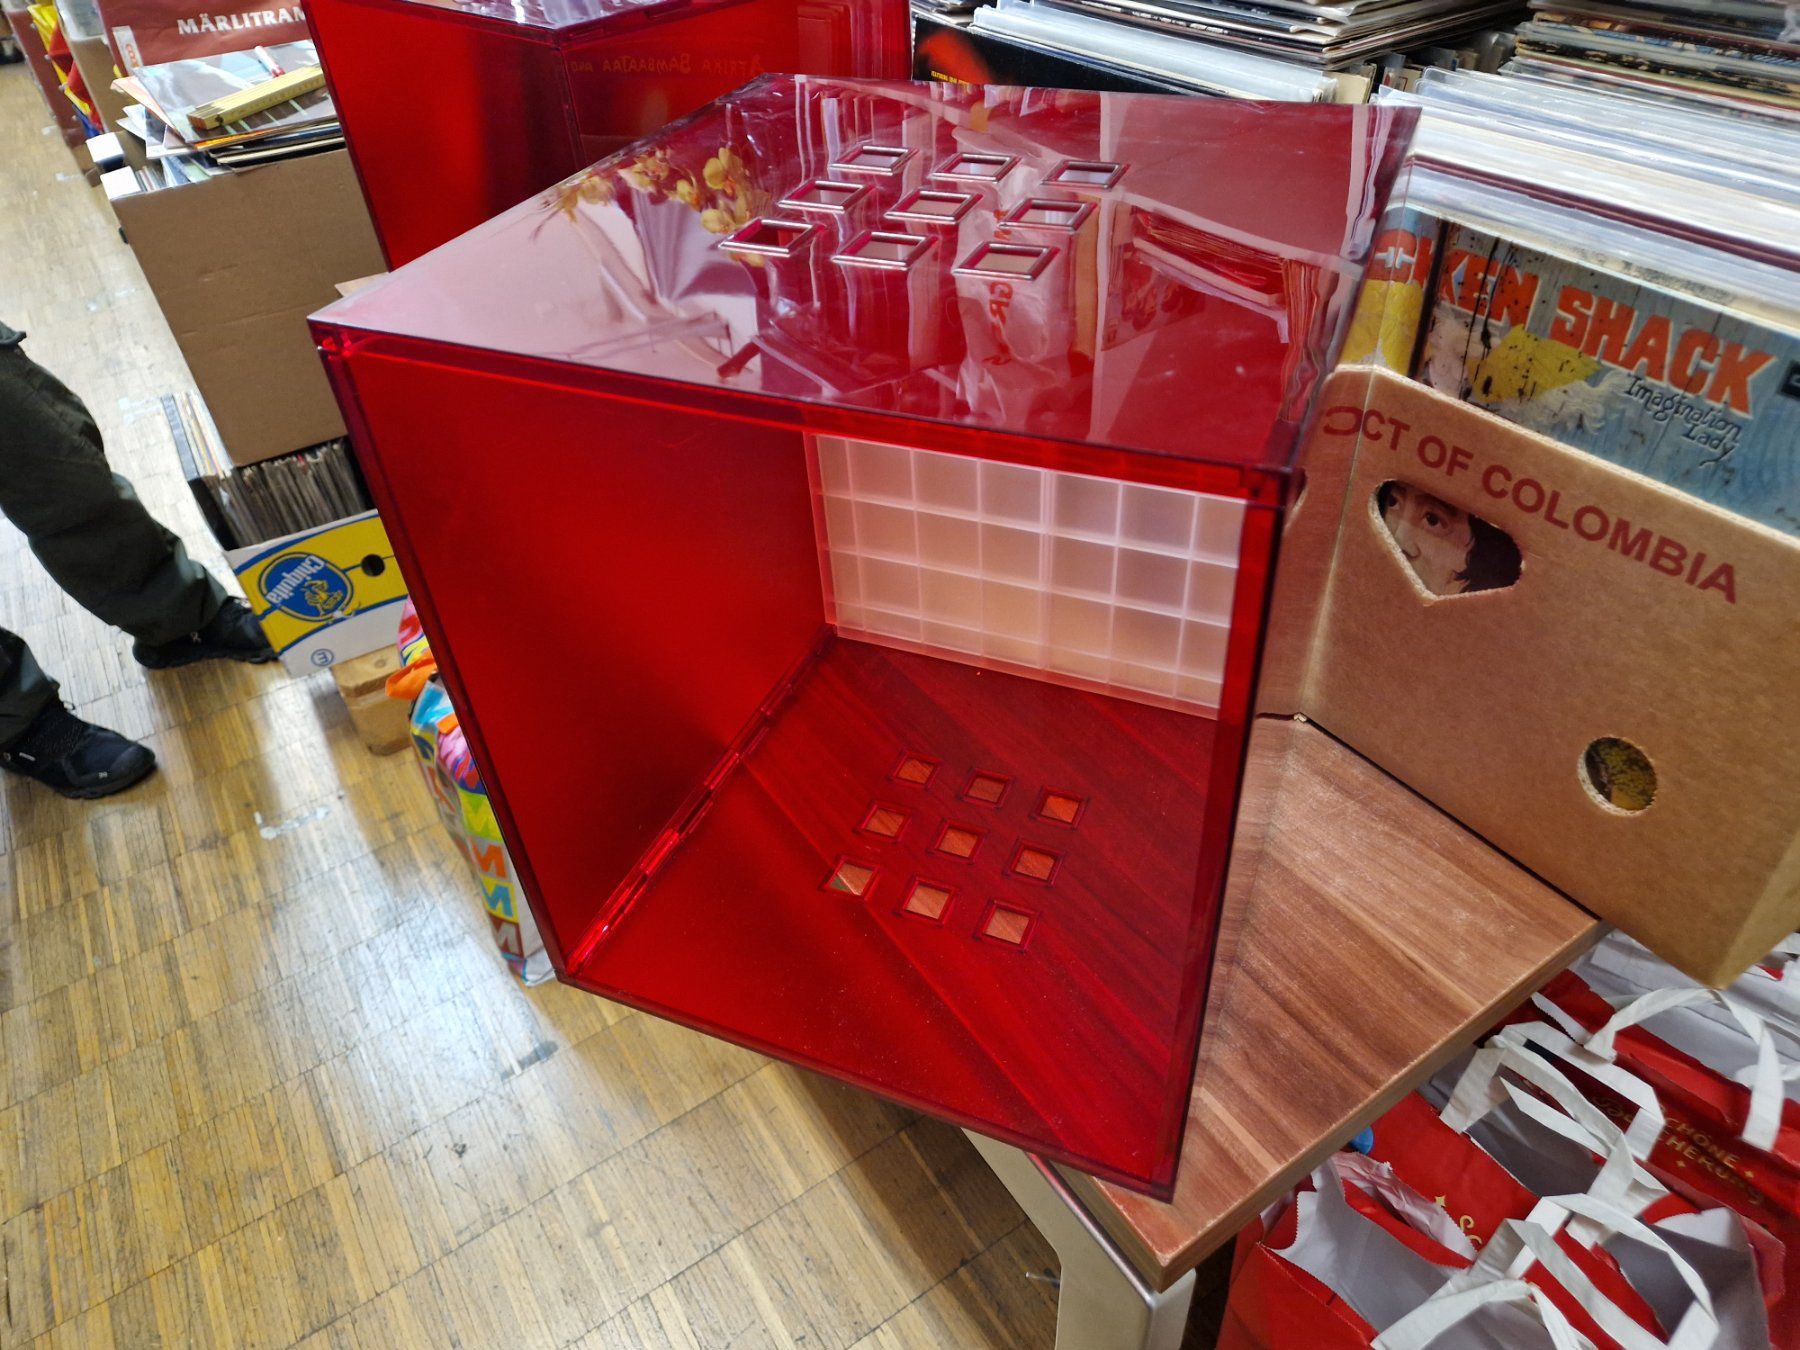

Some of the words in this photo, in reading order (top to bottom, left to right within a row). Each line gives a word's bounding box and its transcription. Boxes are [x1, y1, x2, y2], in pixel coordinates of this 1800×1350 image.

[1550, 284, 1775, 415] SHACK
[1625, 373, 1742, 440] Imagination
[1682, 422, 1736, 467] Lady
[1417, 435, 1474, 477] OF
[1481, 464, 1737, 605] COLOMBIA
[266, 555, 325, 603] Chiquita
